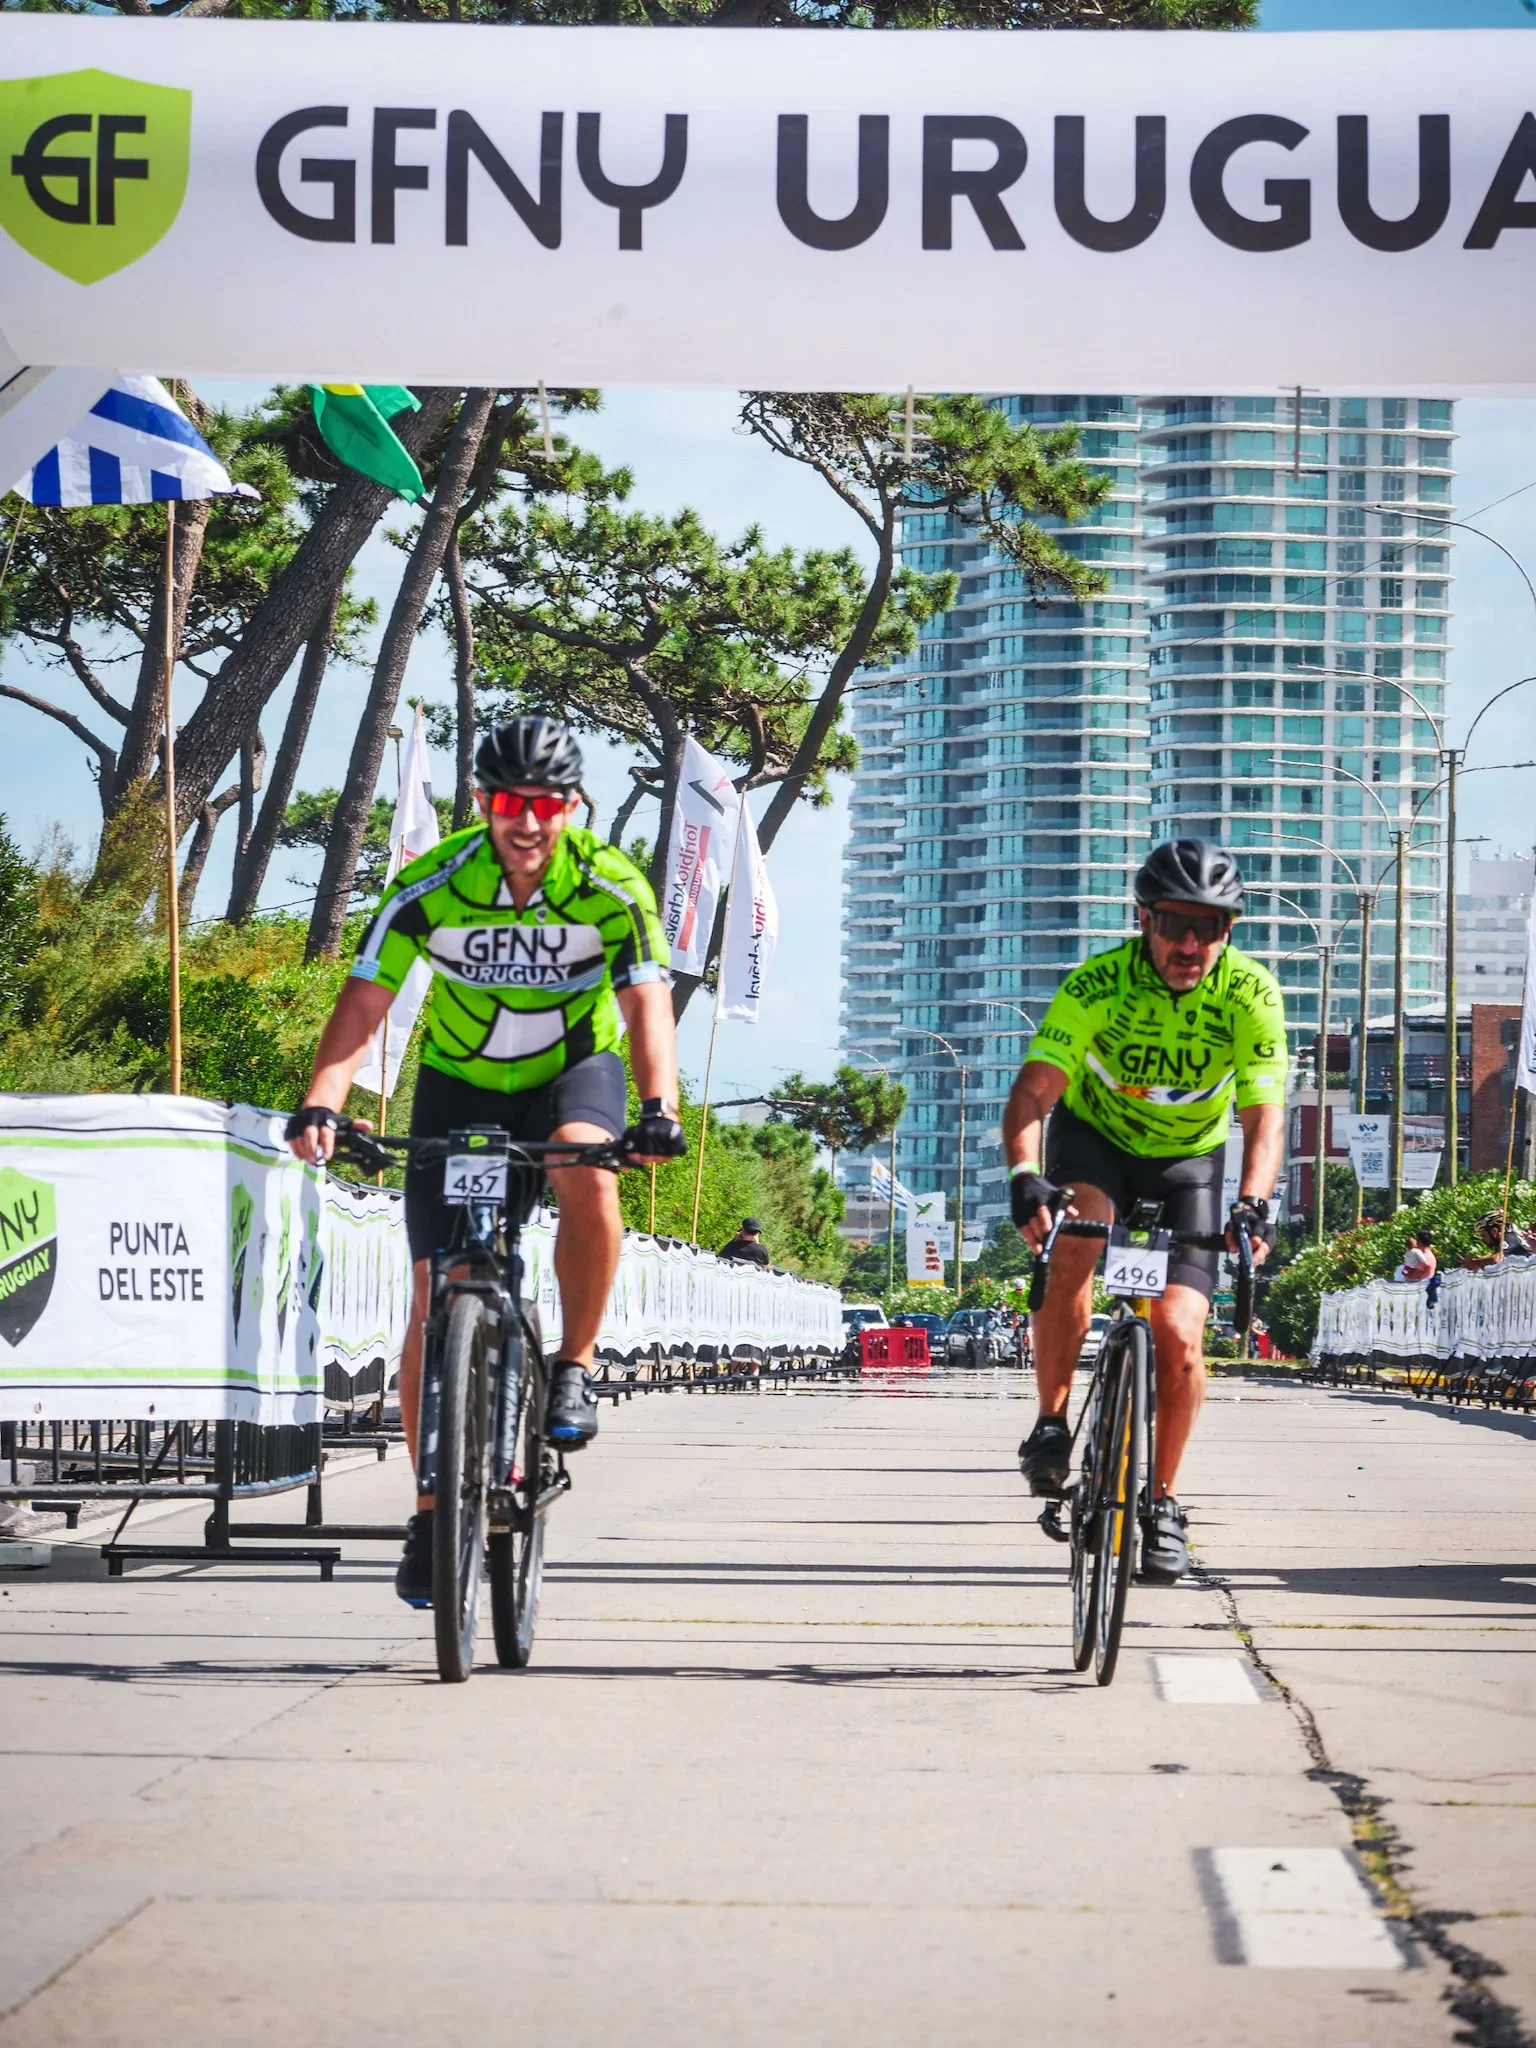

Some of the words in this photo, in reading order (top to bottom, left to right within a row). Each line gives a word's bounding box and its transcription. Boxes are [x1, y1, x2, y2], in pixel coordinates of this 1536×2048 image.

[256, 105, 689, 252] GFNY
[463, 927, 567, 964] GFNY
[461, 964, 572, 984] URUGUAY
[1064, 960, 1119, 999] GFNY
[1119, 1043, 1211, 1078] GFNY
[1120, 1073, 1203, 1089] URUGUAY
[110, 1222, 190, 1256] PUNTA
[99, 1267, 143, 1301] DEL
[150, 1267, 204, 1301] ESTE
[1113, 1266, 1158, 1287] 496
